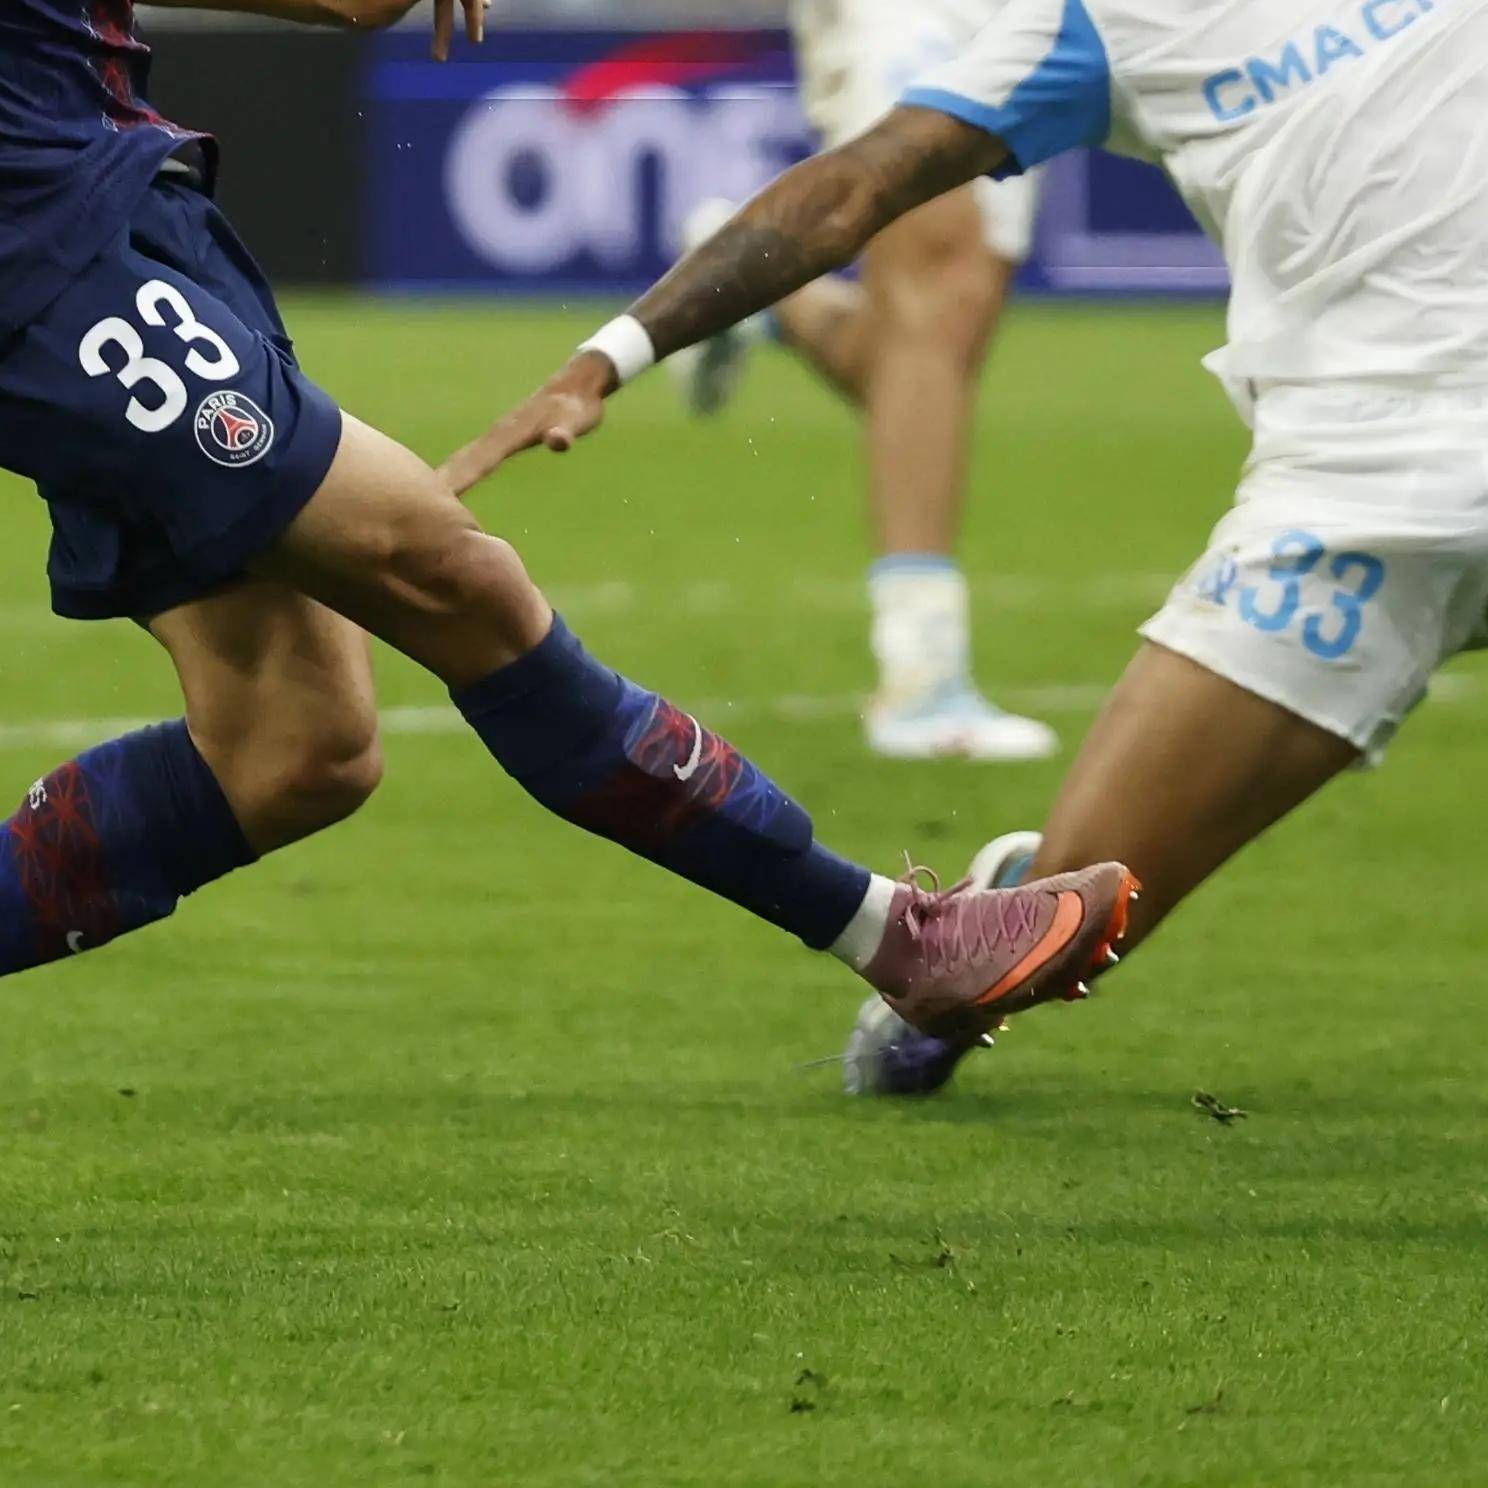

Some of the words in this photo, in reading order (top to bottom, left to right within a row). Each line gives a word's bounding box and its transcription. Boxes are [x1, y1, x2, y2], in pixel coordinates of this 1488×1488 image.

[78, 278, 241, 433] 33
[198, 394, 237, 430] PARIS
[1238, 527, 1385, 659] 33
